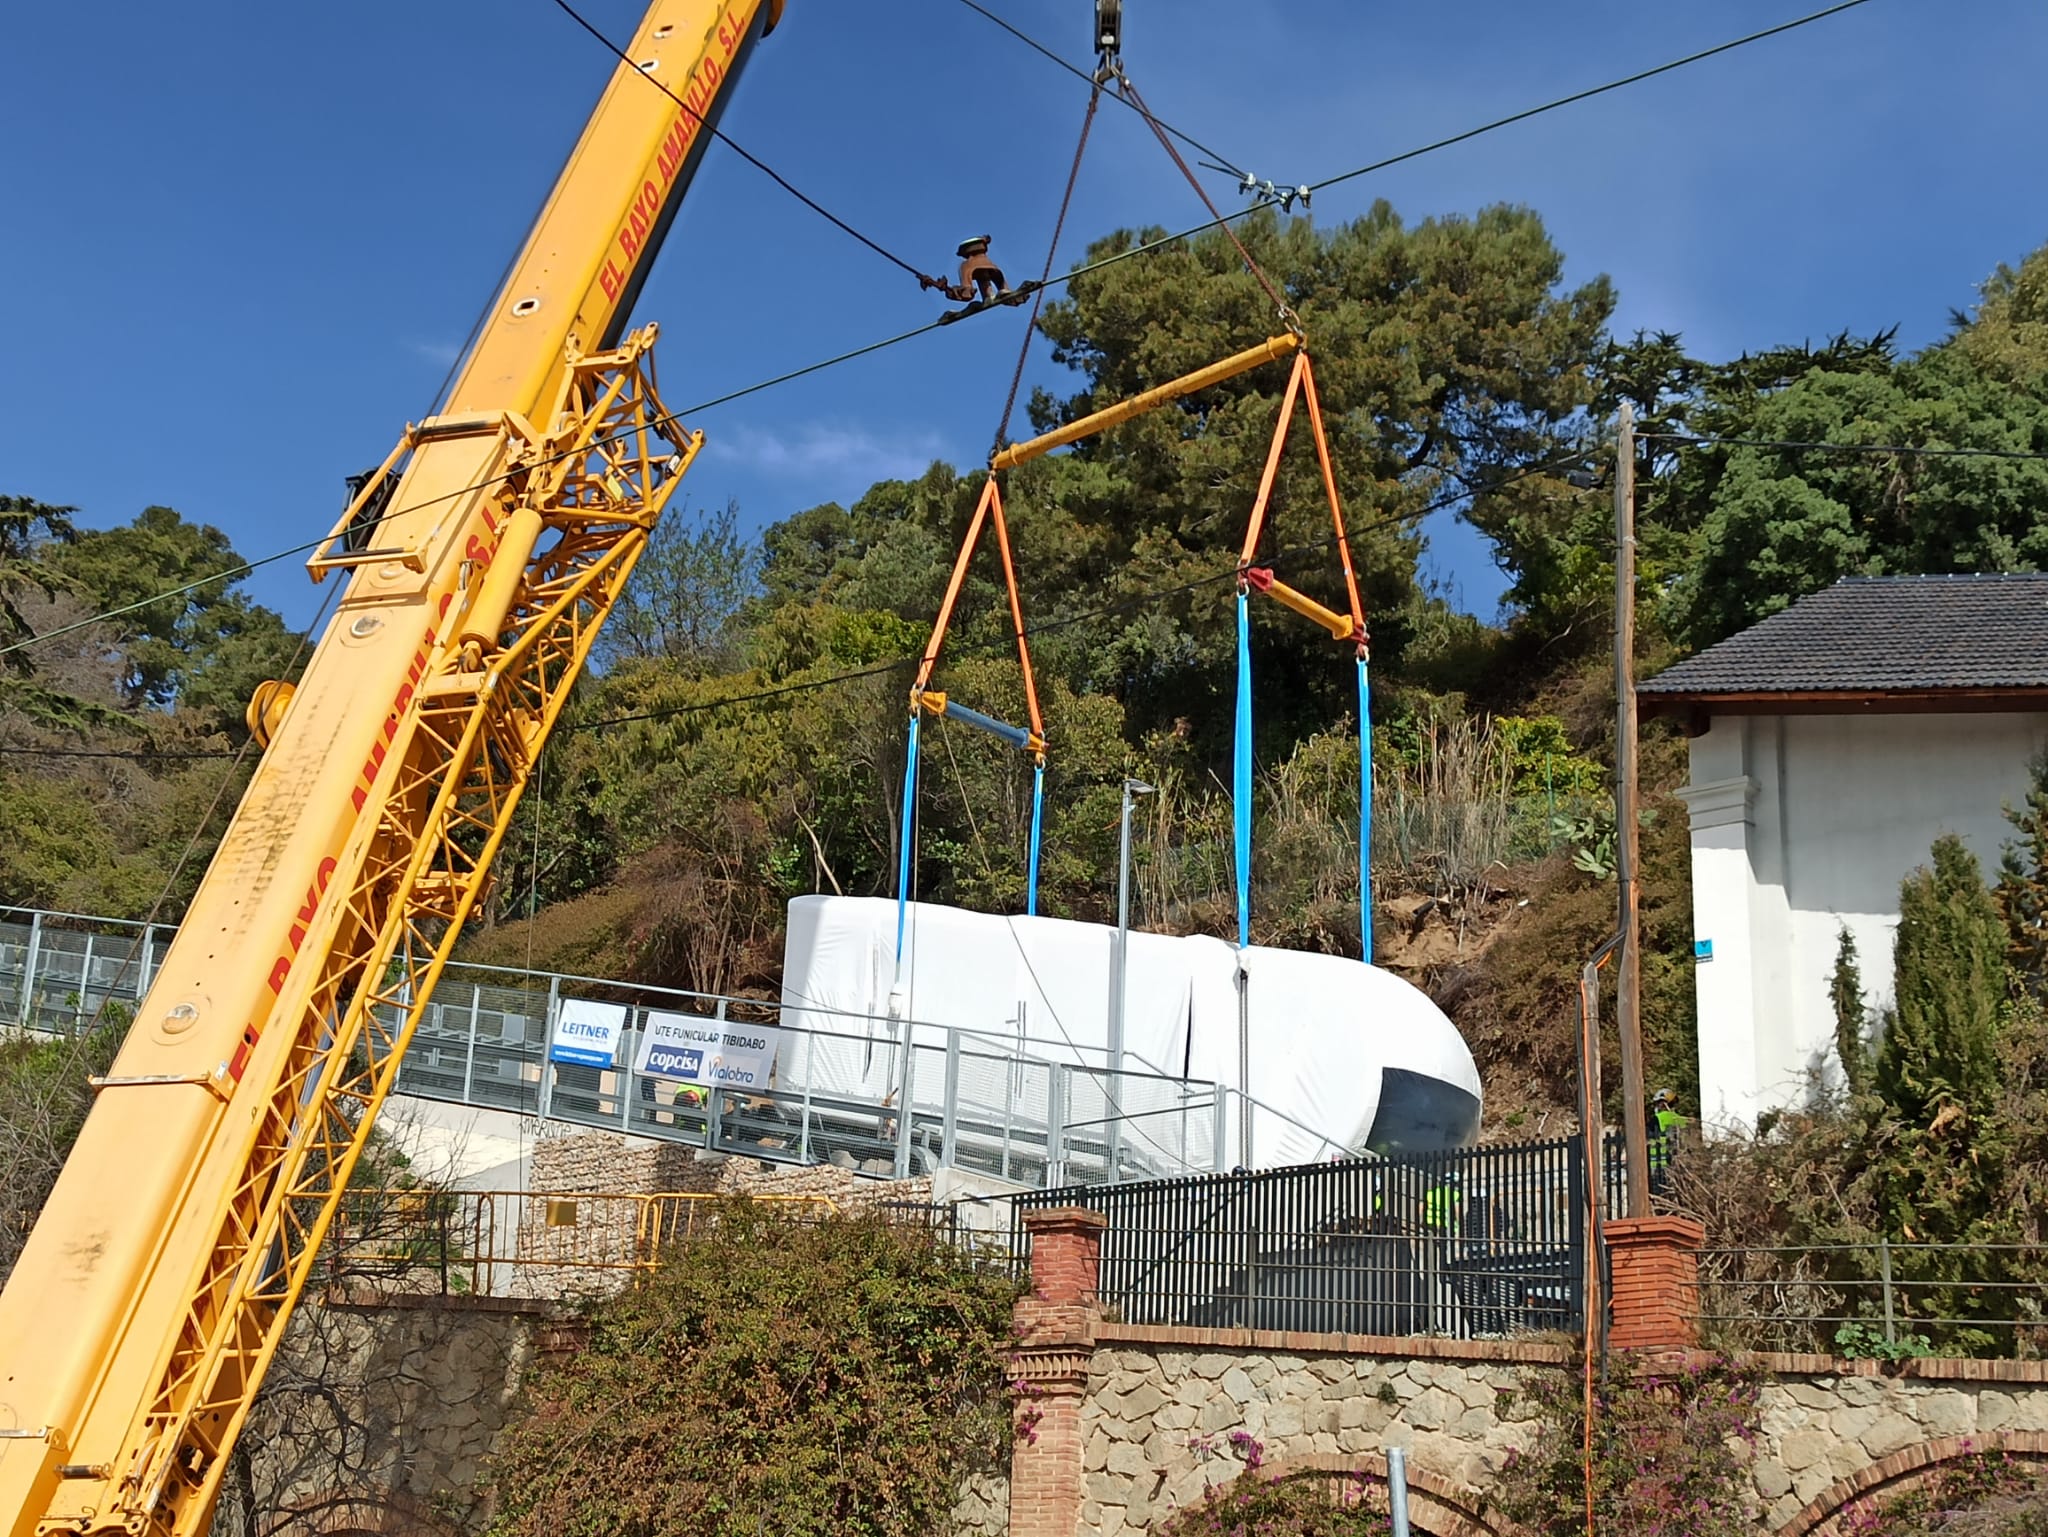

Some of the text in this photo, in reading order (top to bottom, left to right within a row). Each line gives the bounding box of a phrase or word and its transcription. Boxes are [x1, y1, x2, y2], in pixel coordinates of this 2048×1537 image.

[599, 260, 625, 305] EL
[618, 180, 660, 264] RAYO
[718, 10, 746, 57] S.L.
[561, 1021, 610, 1040] LEITNER
[655, 1025, 767, 1050] UTE FUNICULAR TIBIDABO
[708, 1059, 754, 1083] Vialobra
